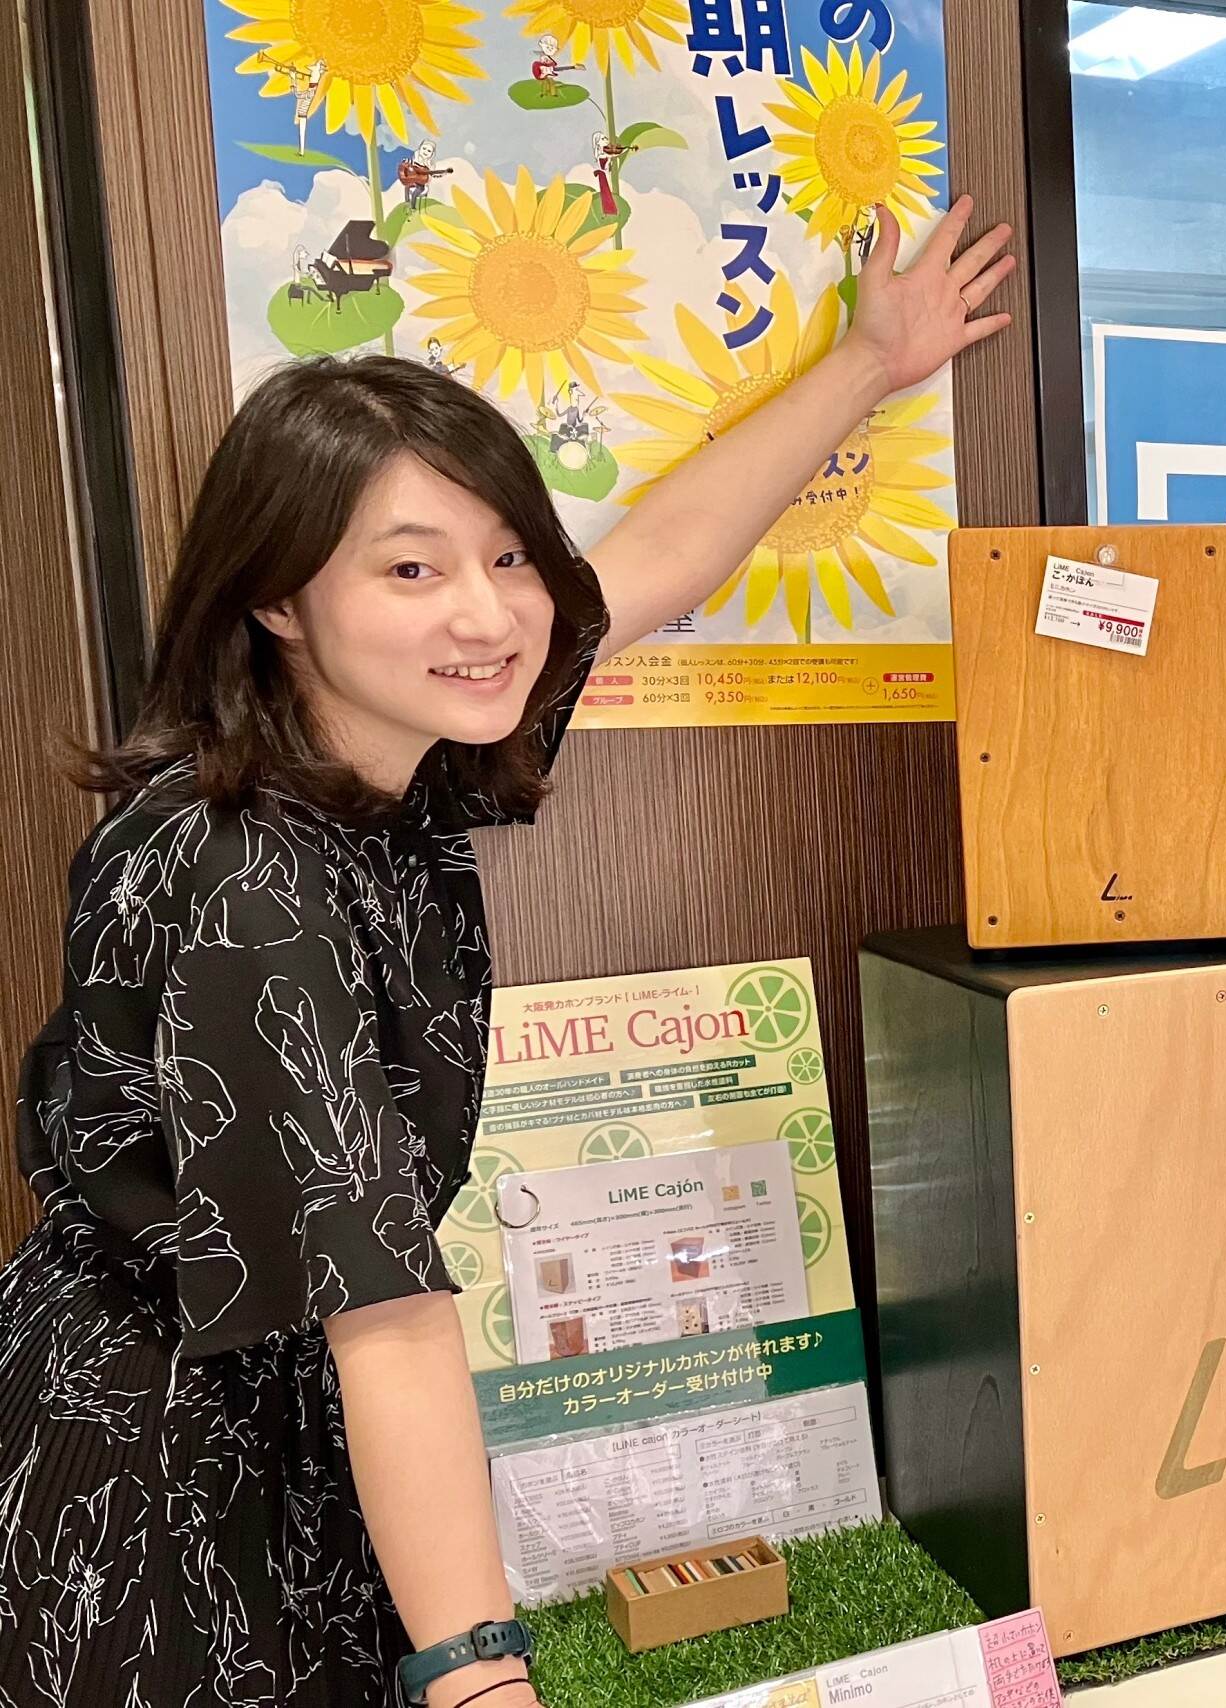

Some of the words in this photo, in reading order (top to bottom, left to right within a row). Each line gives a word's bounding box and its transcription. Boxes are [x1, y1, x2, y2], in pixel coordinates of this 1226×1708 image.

[685, 0, 792, 350] 期レッスン
[490, 1013, 614, 1065] LiME
[626, 1003, 751, 1055] Cajon
[608, 1185, 650, 1205] LiME
[655, 1178, 705, 1198] Cajón
[563, 1362, 773, 1416] カラーオーダー受け付け中
